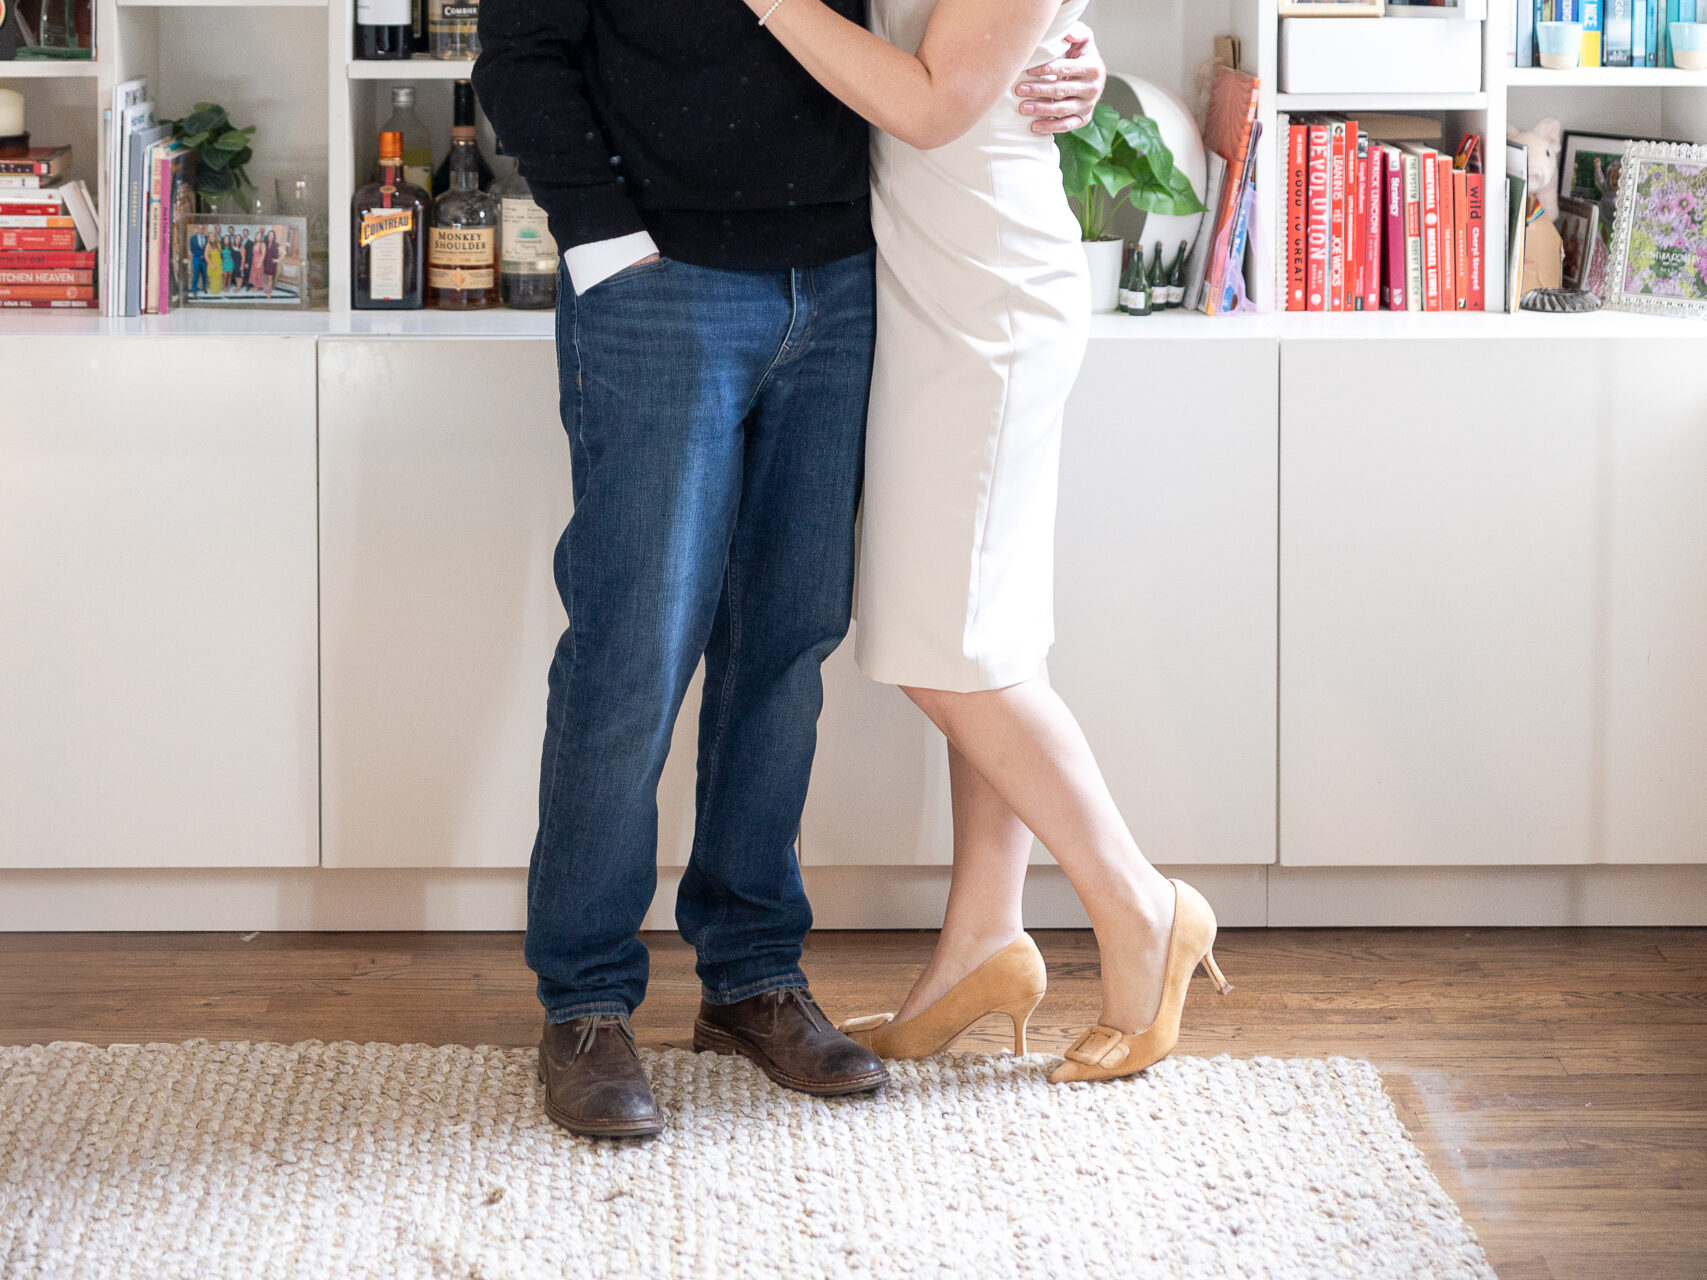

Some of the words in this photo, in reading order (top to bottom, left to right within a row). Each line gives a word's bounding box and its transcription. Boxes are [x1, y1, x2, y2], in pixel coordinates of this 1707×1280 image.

[1584, 3, 1598, 28] NICE
[1334, 154, 1343, 178] LEAN
[1372, 150, 1380, 187] PATRICK
[1295, 169, 1303, 206] GOOD
[1308, 130, 1328, 259] DEVOLUTION
[1390, 176, 1400, 217] Strategy
[1426, 158, 1435, 210] MONEYBALL
[1370, 189, 1380, 233] LENCIONI
[1470, 186, 1482, 220] wild
[364, 216, 409, 240] COINTREAU
[438, 232, 482, 241] MONKEY
[1295, 213, 1302, 230] TO
[434, 240, 486, 250] SHOULDER
[1332, 234, 1342, 254] JOE
[1426, 228, 1437, 267] MICHAEL
[1472, 226, 1480, 256] Cheryl
[29, 256, 45, 264] eat
[1294, 238, 1302, 282] GREAT
[1332, 254, 1342, 286] WICKS
[1472, 257, 1480, 290] Strayed
[36, 272, 75, 282] HEAVEN
[1428, 268, 1437, 296] LEWIS
